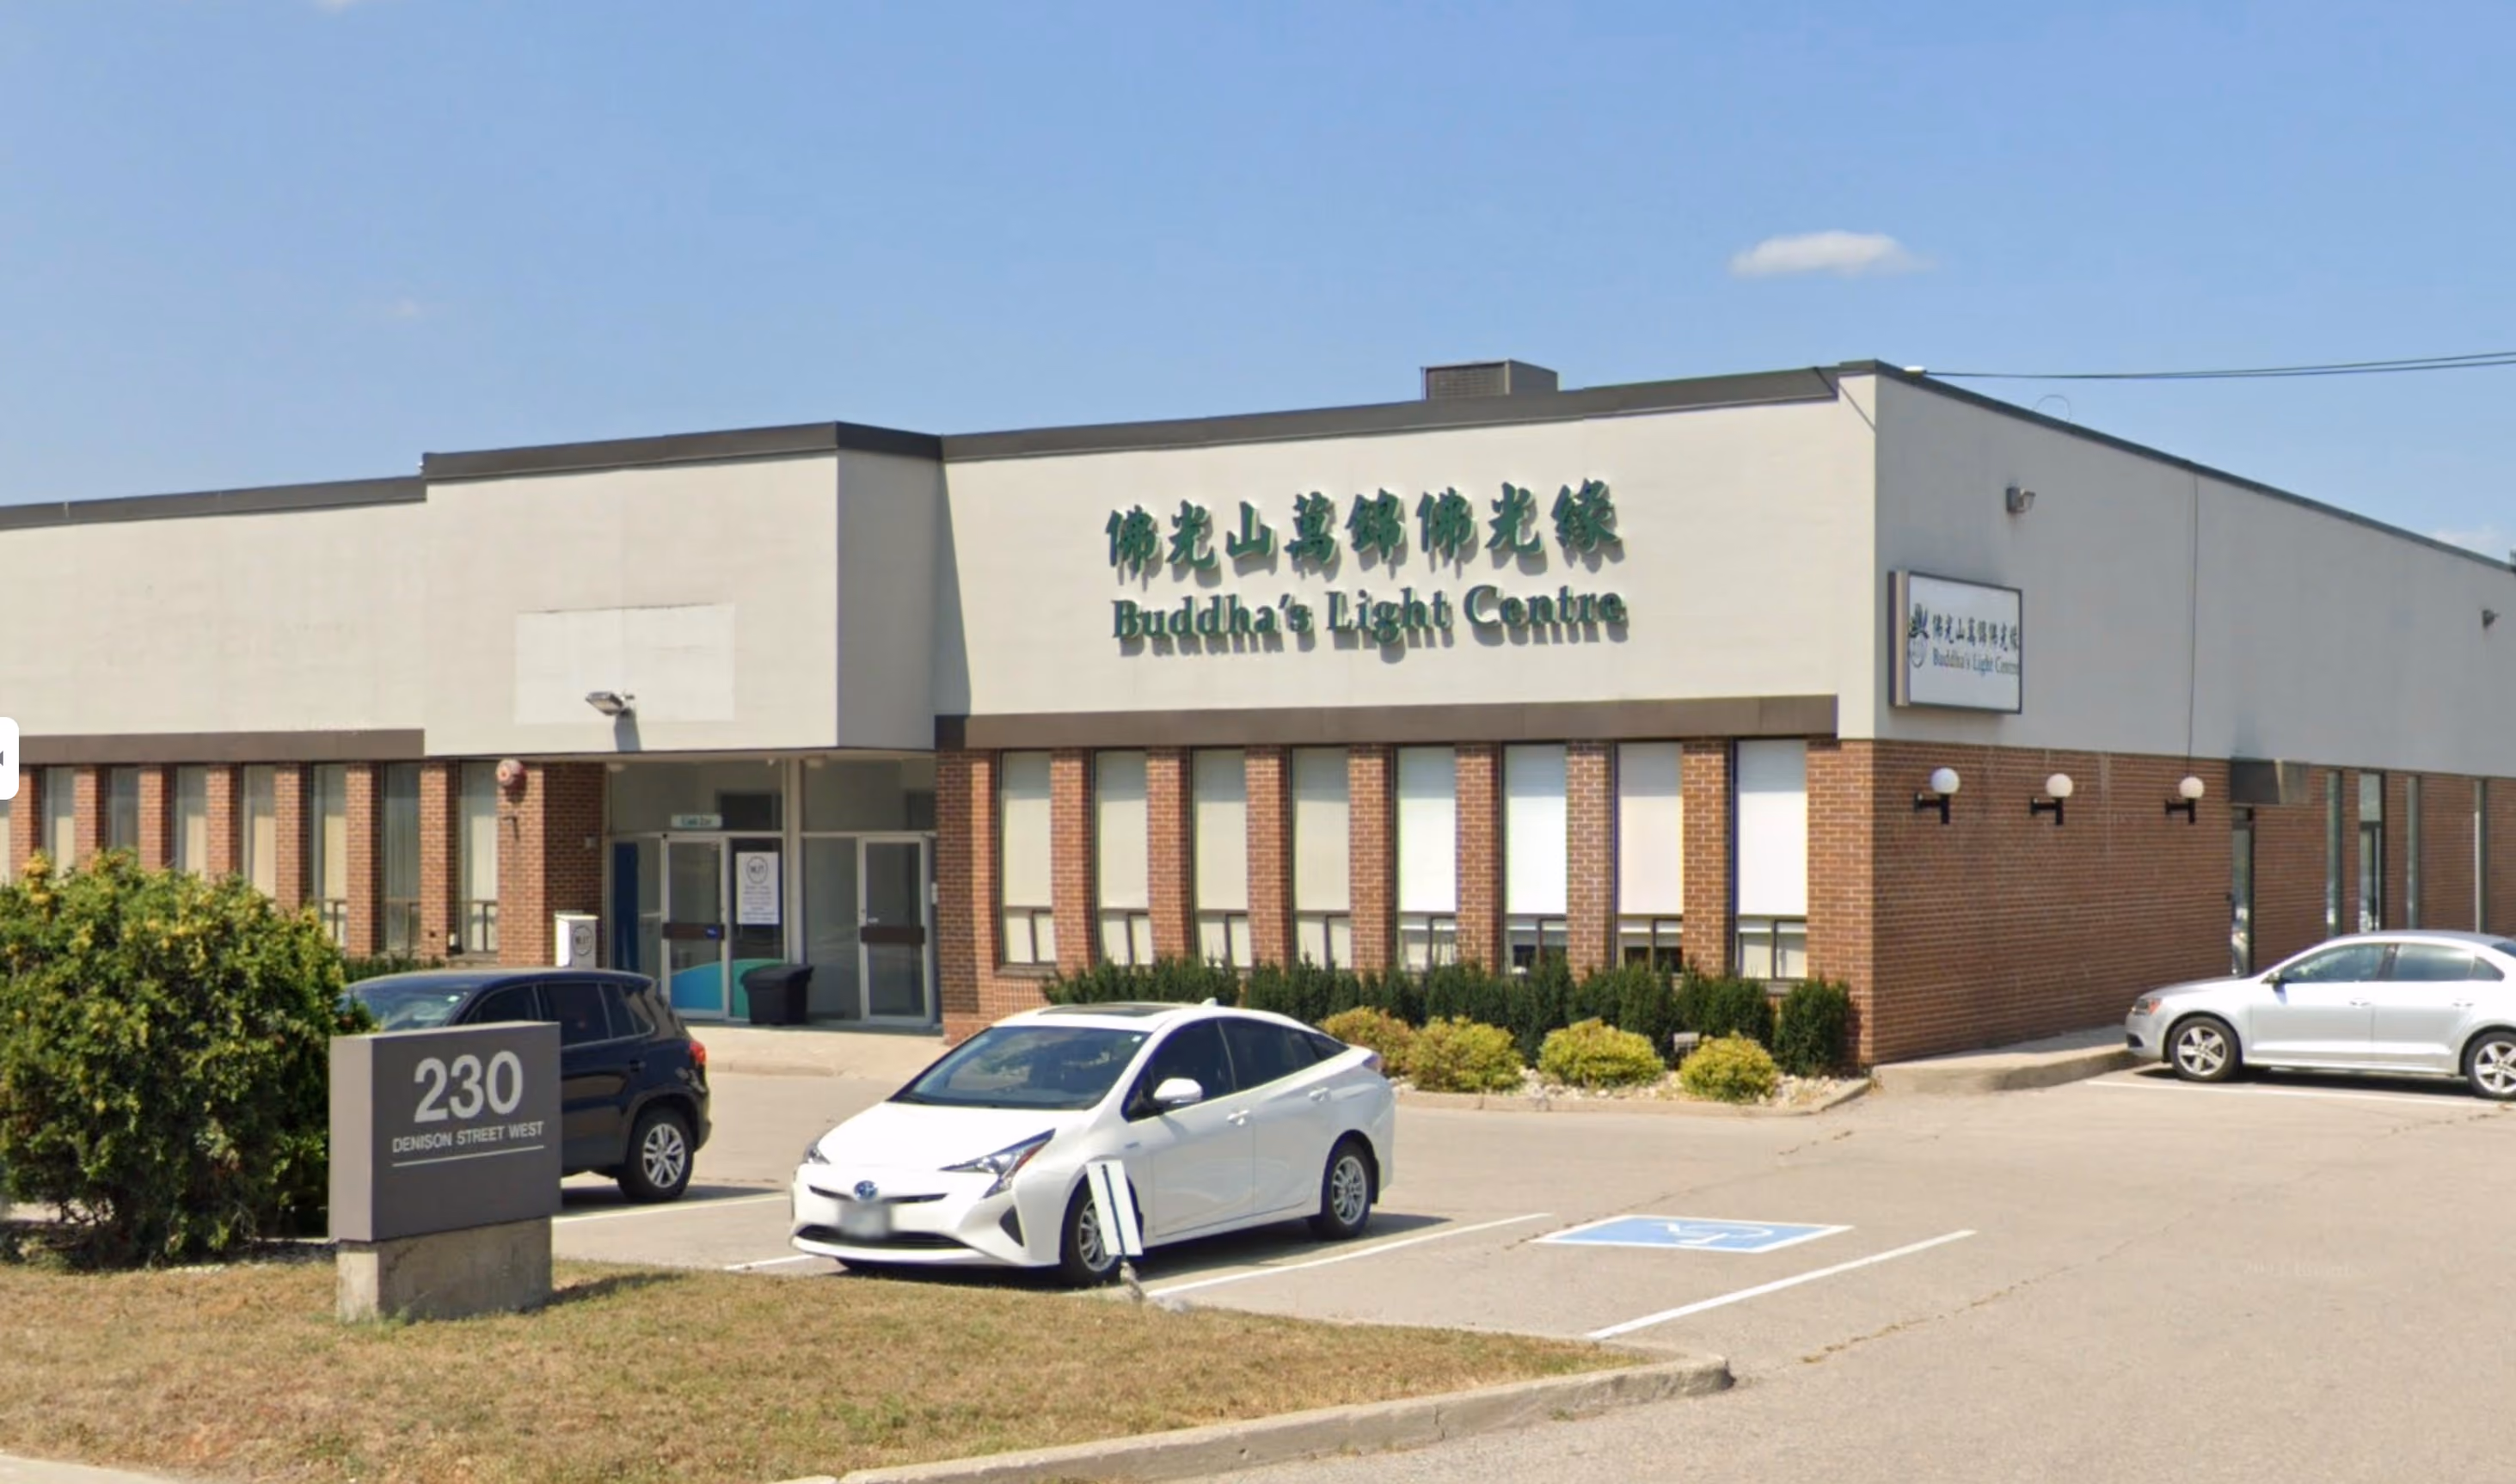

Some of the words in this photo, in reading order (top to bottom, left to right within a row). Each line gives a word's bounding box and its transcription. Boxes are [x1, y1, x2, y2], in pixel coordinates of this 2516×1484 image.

[1105, 478, 1622, 574] 佛光山萬錦佛光緣
[1111, 592, 1315, 638] Buddha's
[1324, 586, 1454, 643] Light
[1464, 584, 1628, 629] Centre
[414, 1050, 524, 1123] 230
[392, 1131, 452, 1154] DENISON
[457, 1125, 506, 1145] STREET
[508, 1120, 544, 1139] WEST
